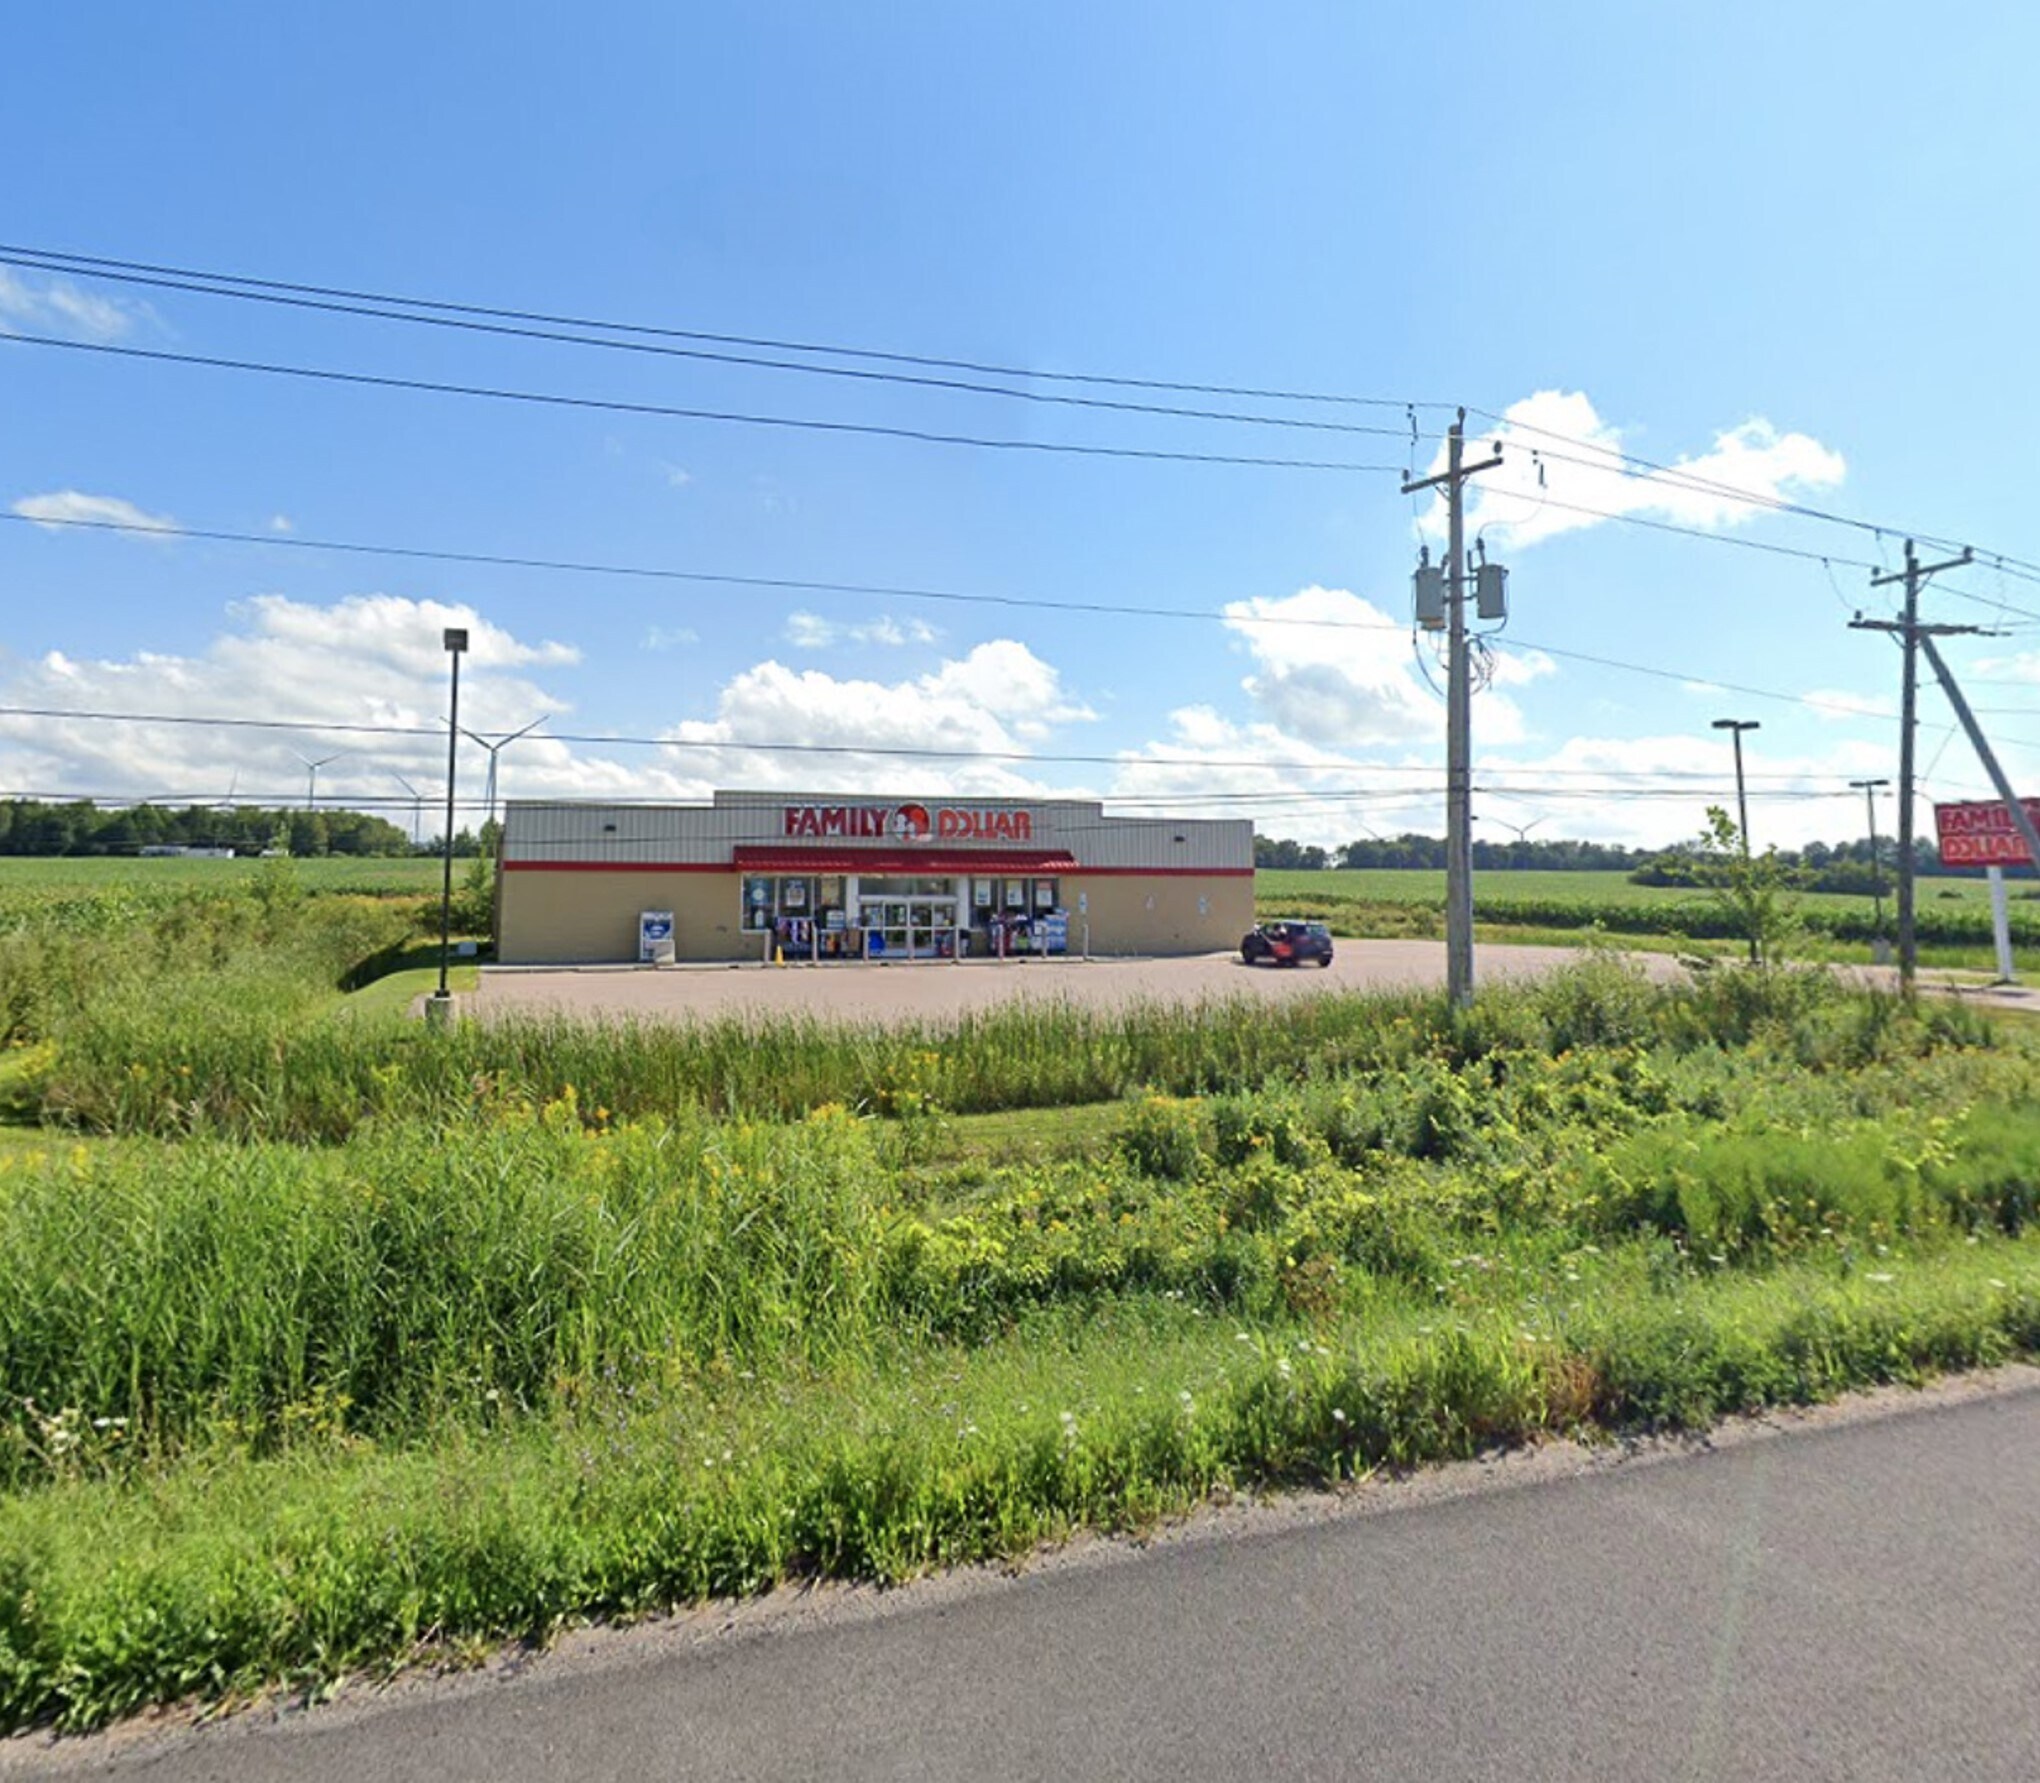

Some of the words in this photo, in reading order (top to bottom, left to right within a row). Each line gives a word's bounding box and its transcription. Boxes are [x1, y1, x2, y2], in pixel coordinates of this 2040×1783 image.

[784, 806, 889, 838] FAMILY
[938, 808, 1031, 841] DOLLAR
[1939, 805, 2024, 832] FAMIL
[1942, 835, 2030, 859] DOLLAR
